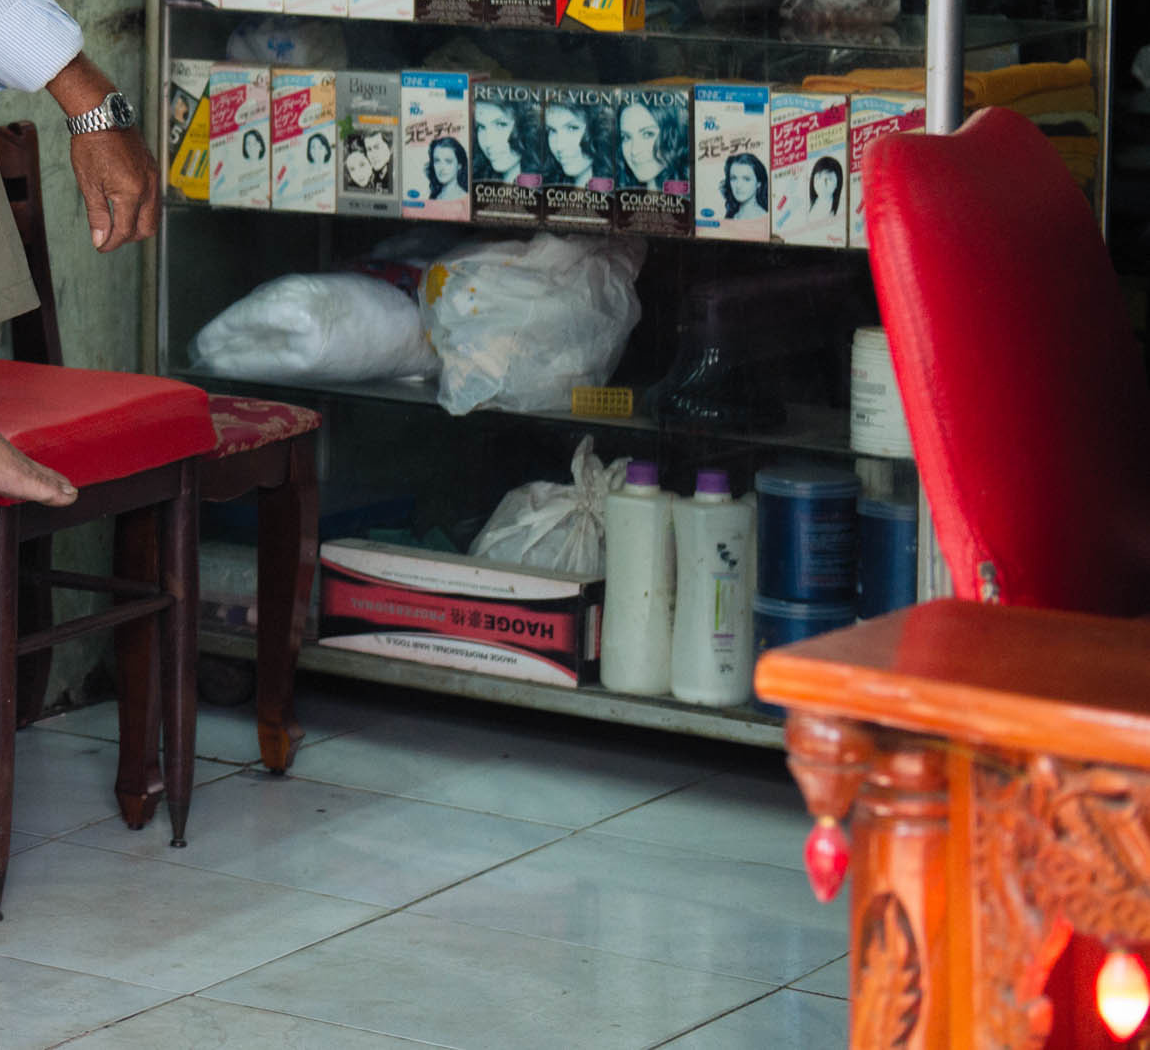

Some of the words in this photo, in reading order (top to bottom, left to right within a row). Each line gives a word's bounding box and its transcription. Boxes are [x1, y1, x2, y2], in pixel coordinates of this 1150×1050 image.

[474, 85, 540, 101] REVLON
[545, 88, 613, 105] REVLON
[618, 91, 687, 107] REVLON
[853, 118, 900, 144] レディース
[475, 185, 537, 200] COLORSILK
[546, 189, 609, 204] COLORSILK
[620, 192, 684, 208] COLORSILK
[350, 598, 446, 622] PROFESSIONAL
[484, 613, 554, 639] HAOGE
[433, 644, 488, 660] PROFESSIONAL
